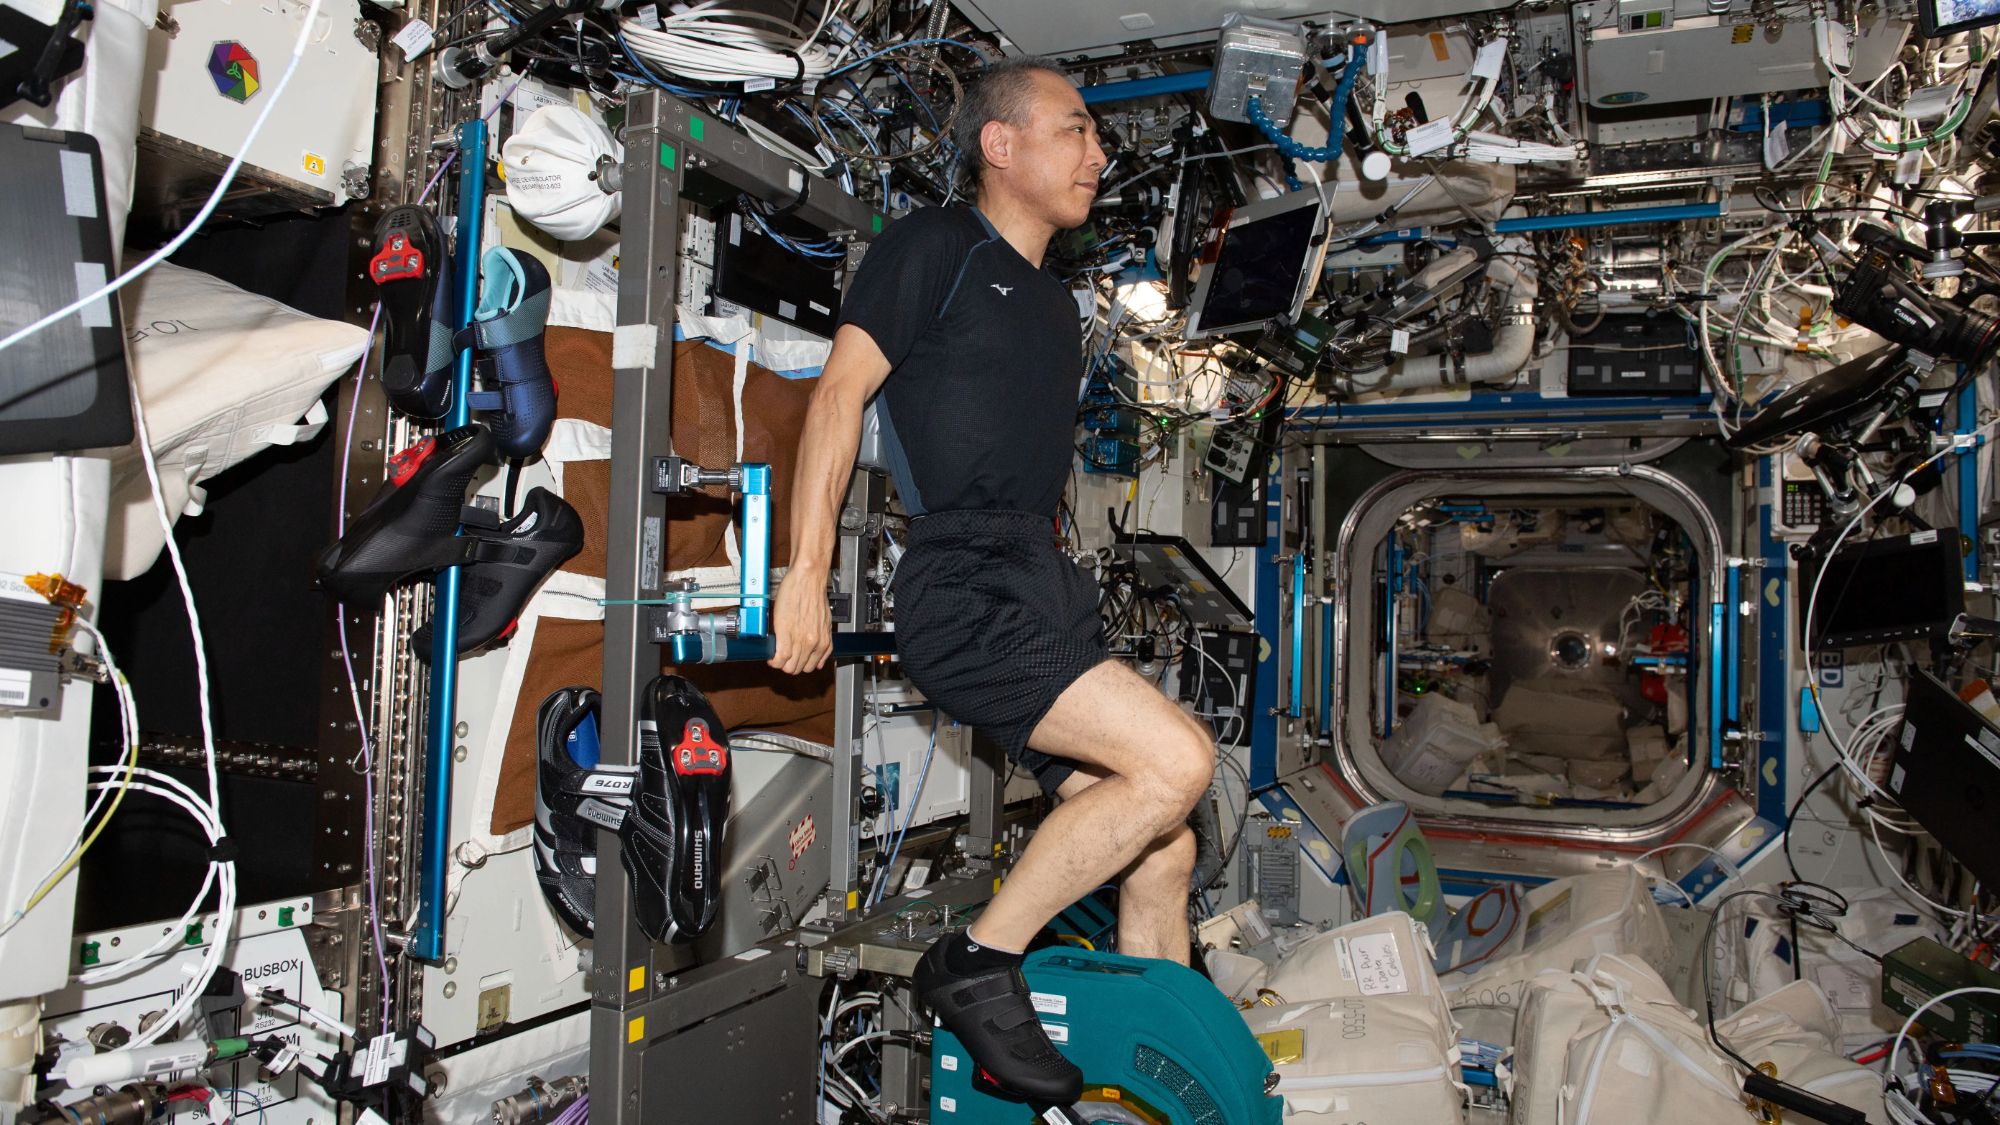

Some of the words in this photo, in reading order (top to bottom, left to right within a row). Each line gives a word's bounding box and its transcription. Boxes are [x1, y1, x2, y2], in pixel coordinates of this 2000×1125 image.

[1893, 307, 1917, 326] Canon
[587, 807, 622, 827] SHIMANO
[694, 829, 703, 890] SHIMANO
[244, 958, 299, 982] BUSBOX
[257, 1008, 274, 1021] J10
[254, 1019, 276, 1030] RS232
[255, 1084, 272, 1099] J11
[251, 1095, 273, 1107] R232
